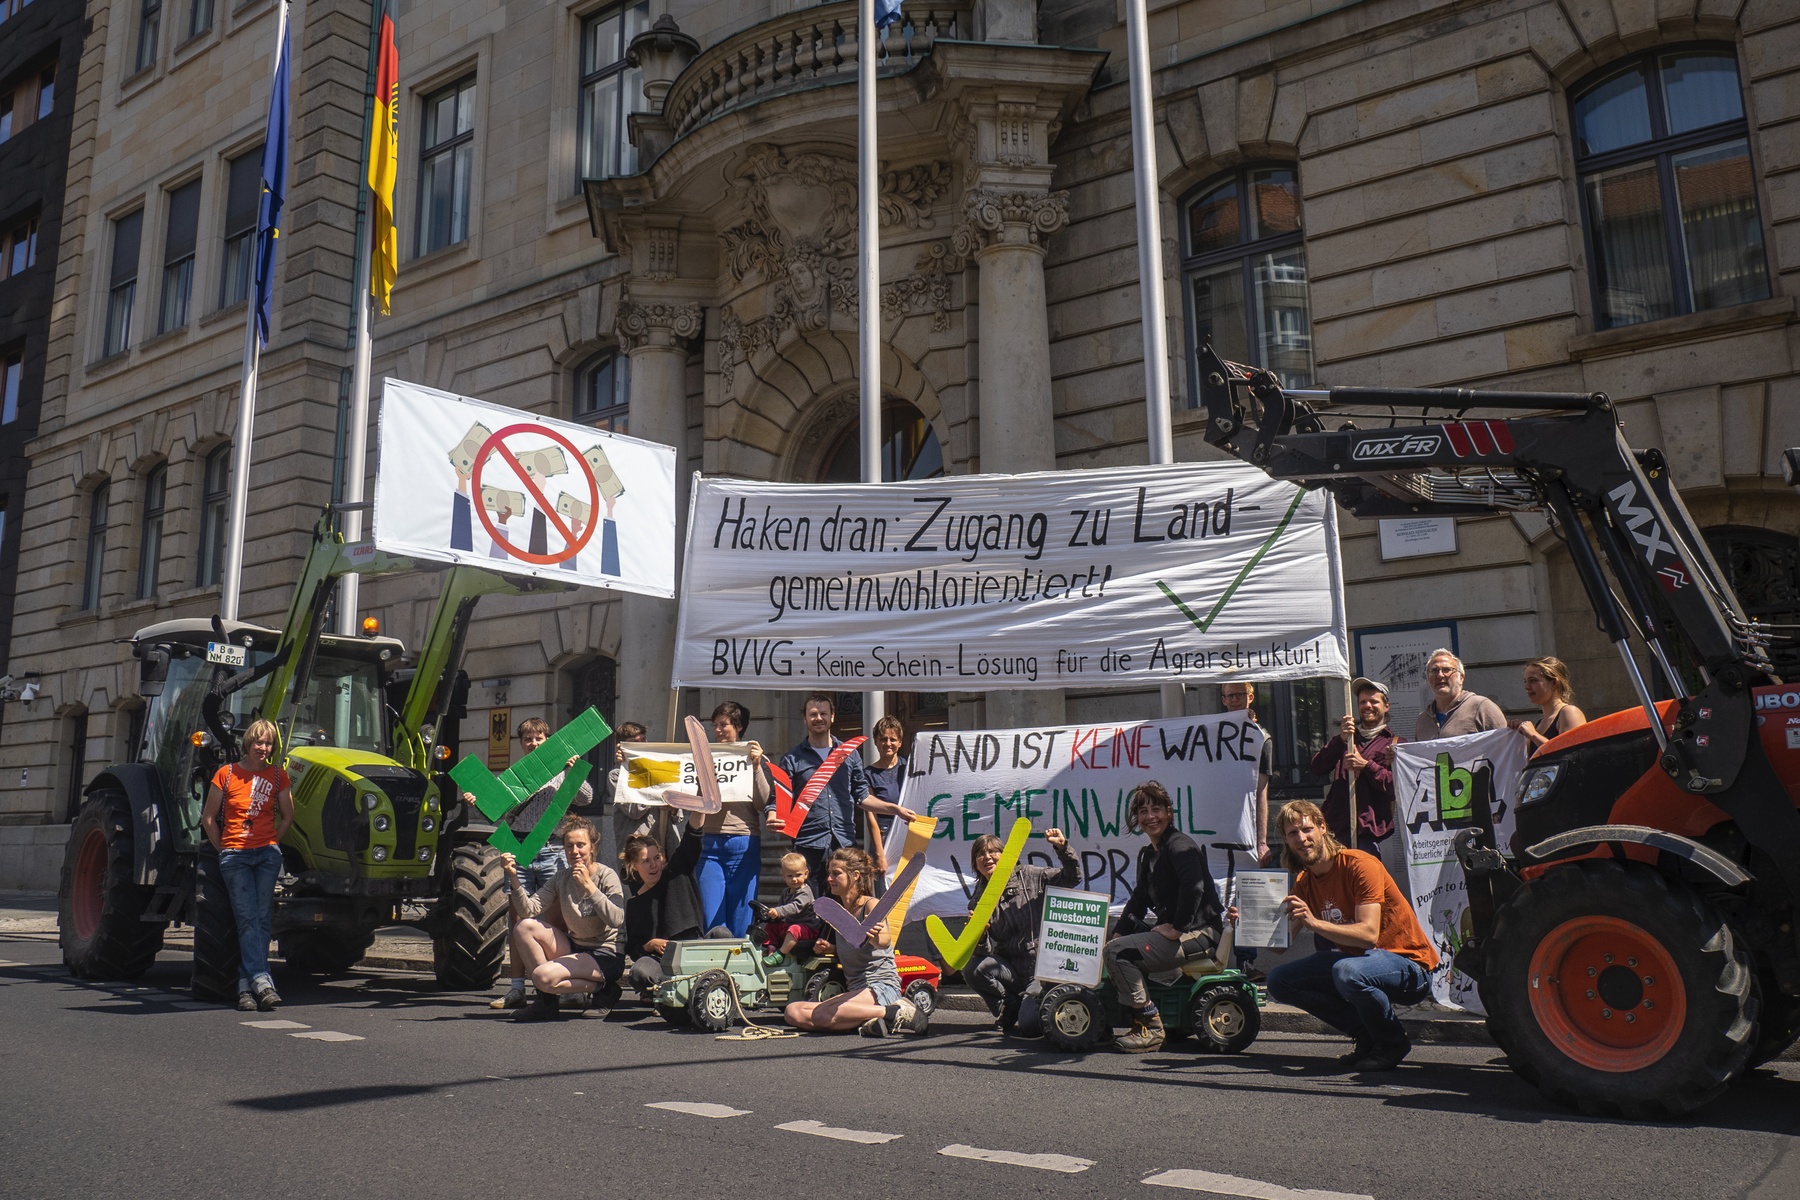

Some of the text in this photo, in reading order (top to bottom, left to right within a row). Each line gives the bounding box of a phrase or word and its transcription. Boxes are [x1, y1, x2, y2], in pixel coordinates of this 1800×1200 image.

[1359, 442, 1400, 456] MX
[714, 487, 1261, 562] Haken dran: Zugang zu Land-
[1608, 480, 1676, 566] MX
[768, 564, 1113, 623] gemeinwohlorientiert!
[220, 645, 226, 654] B
[225, 655, 242, 665] 820
[711, 638, 1320, 682] BVVG: Keine Schein-Lösung für die Agrarstruktur!
[495, 692, 507, 705] 54
[908, 720, 1258, 778] LAND IST KEINE WARE
[684, 759, 747, 773] aion
[1050, 897, 1101, 913] Bauern vor
[1049, 909, 1100, 925] Investoren!
[1047, 927, 1099, 945] Bodenmarkt
[1045, 941, 1098, 957] reformieren!
